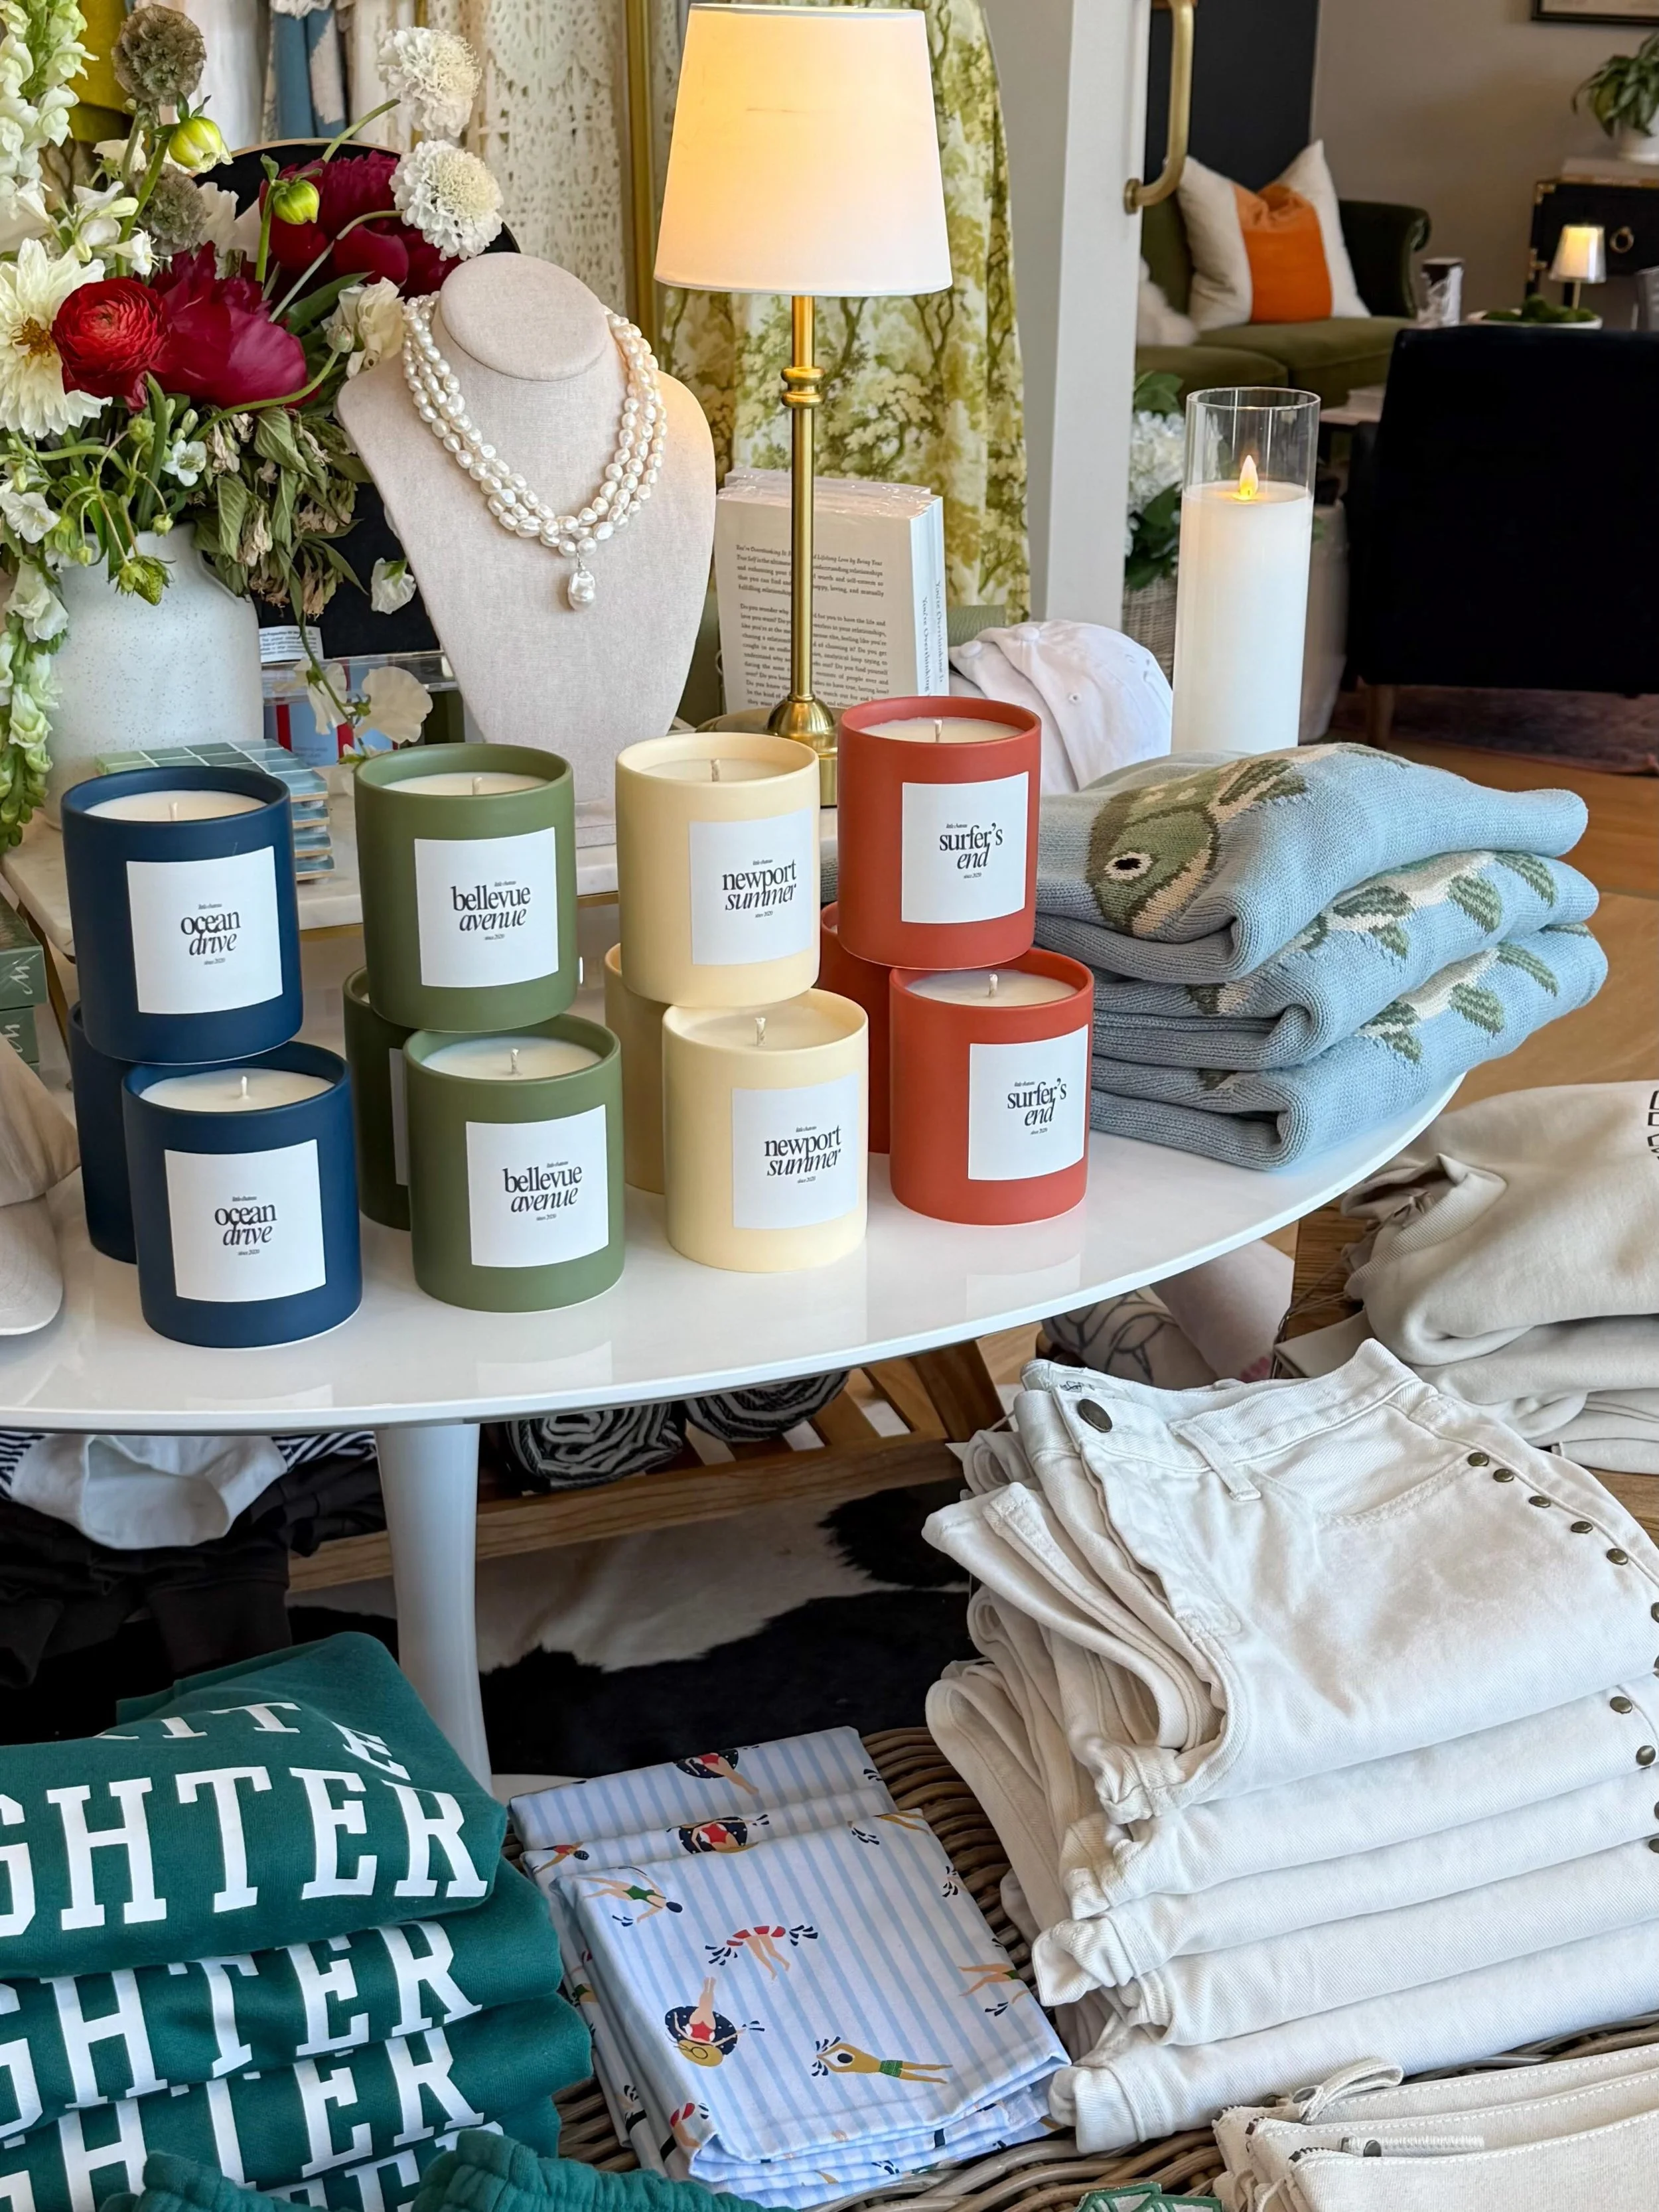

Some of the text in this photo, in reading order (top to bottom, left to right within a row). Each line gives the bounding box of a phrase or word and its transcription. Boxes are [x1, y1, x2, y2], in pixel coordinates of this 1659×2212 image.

[940, 822, 1003, 851] surfer's
[957, 843, 990, 869] end
[722, 859, 797, 892] newport
[451, 885, 531, 911] bellevue
[725, 883, 797, 911] summer
[180, 911, 241, 935] ocean
[459, 908, 527, 932] avenue
[188, 929, 237, 956] drive
[1007, 1077, 1067, 1110] surfer's
[1024, 1098, 1056, 1126] end
[764, 1124, 842, 1159] newport
[766, 1148, 841, 1176] summer
[502, 1165, 583, 1193] bellevue
[510, 1187, 579, 1213] avenue
[214, 1204, 277, 1226] ocean
[222, 1221, 273, 1246] drive
[92, 1702, 411, 1781] ITE
[0, 2027, 484, 2212] HTER
